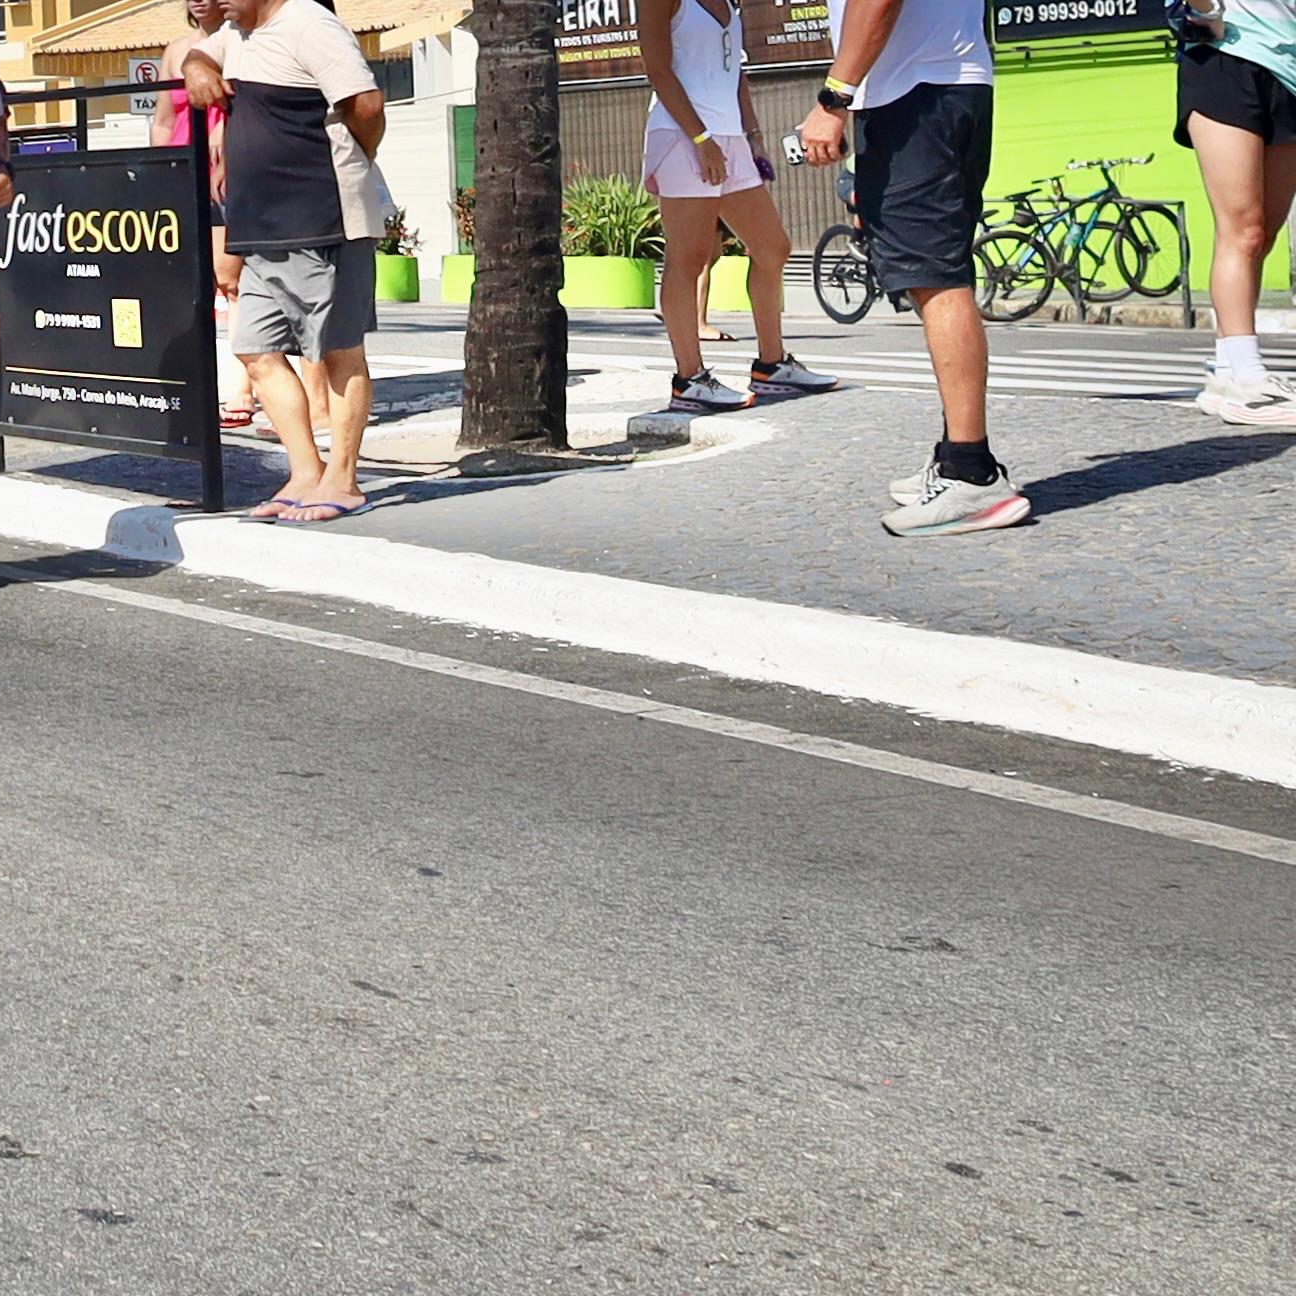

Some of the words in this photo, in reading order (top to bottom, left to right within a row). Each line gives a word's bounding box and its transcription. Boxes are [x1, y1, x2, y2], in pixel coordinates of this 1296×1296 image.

[791, 5, 830, 21] ENTRAD
[1013, 6, 1034, 24] 79
[134, 97, 158, 110] TÁX
